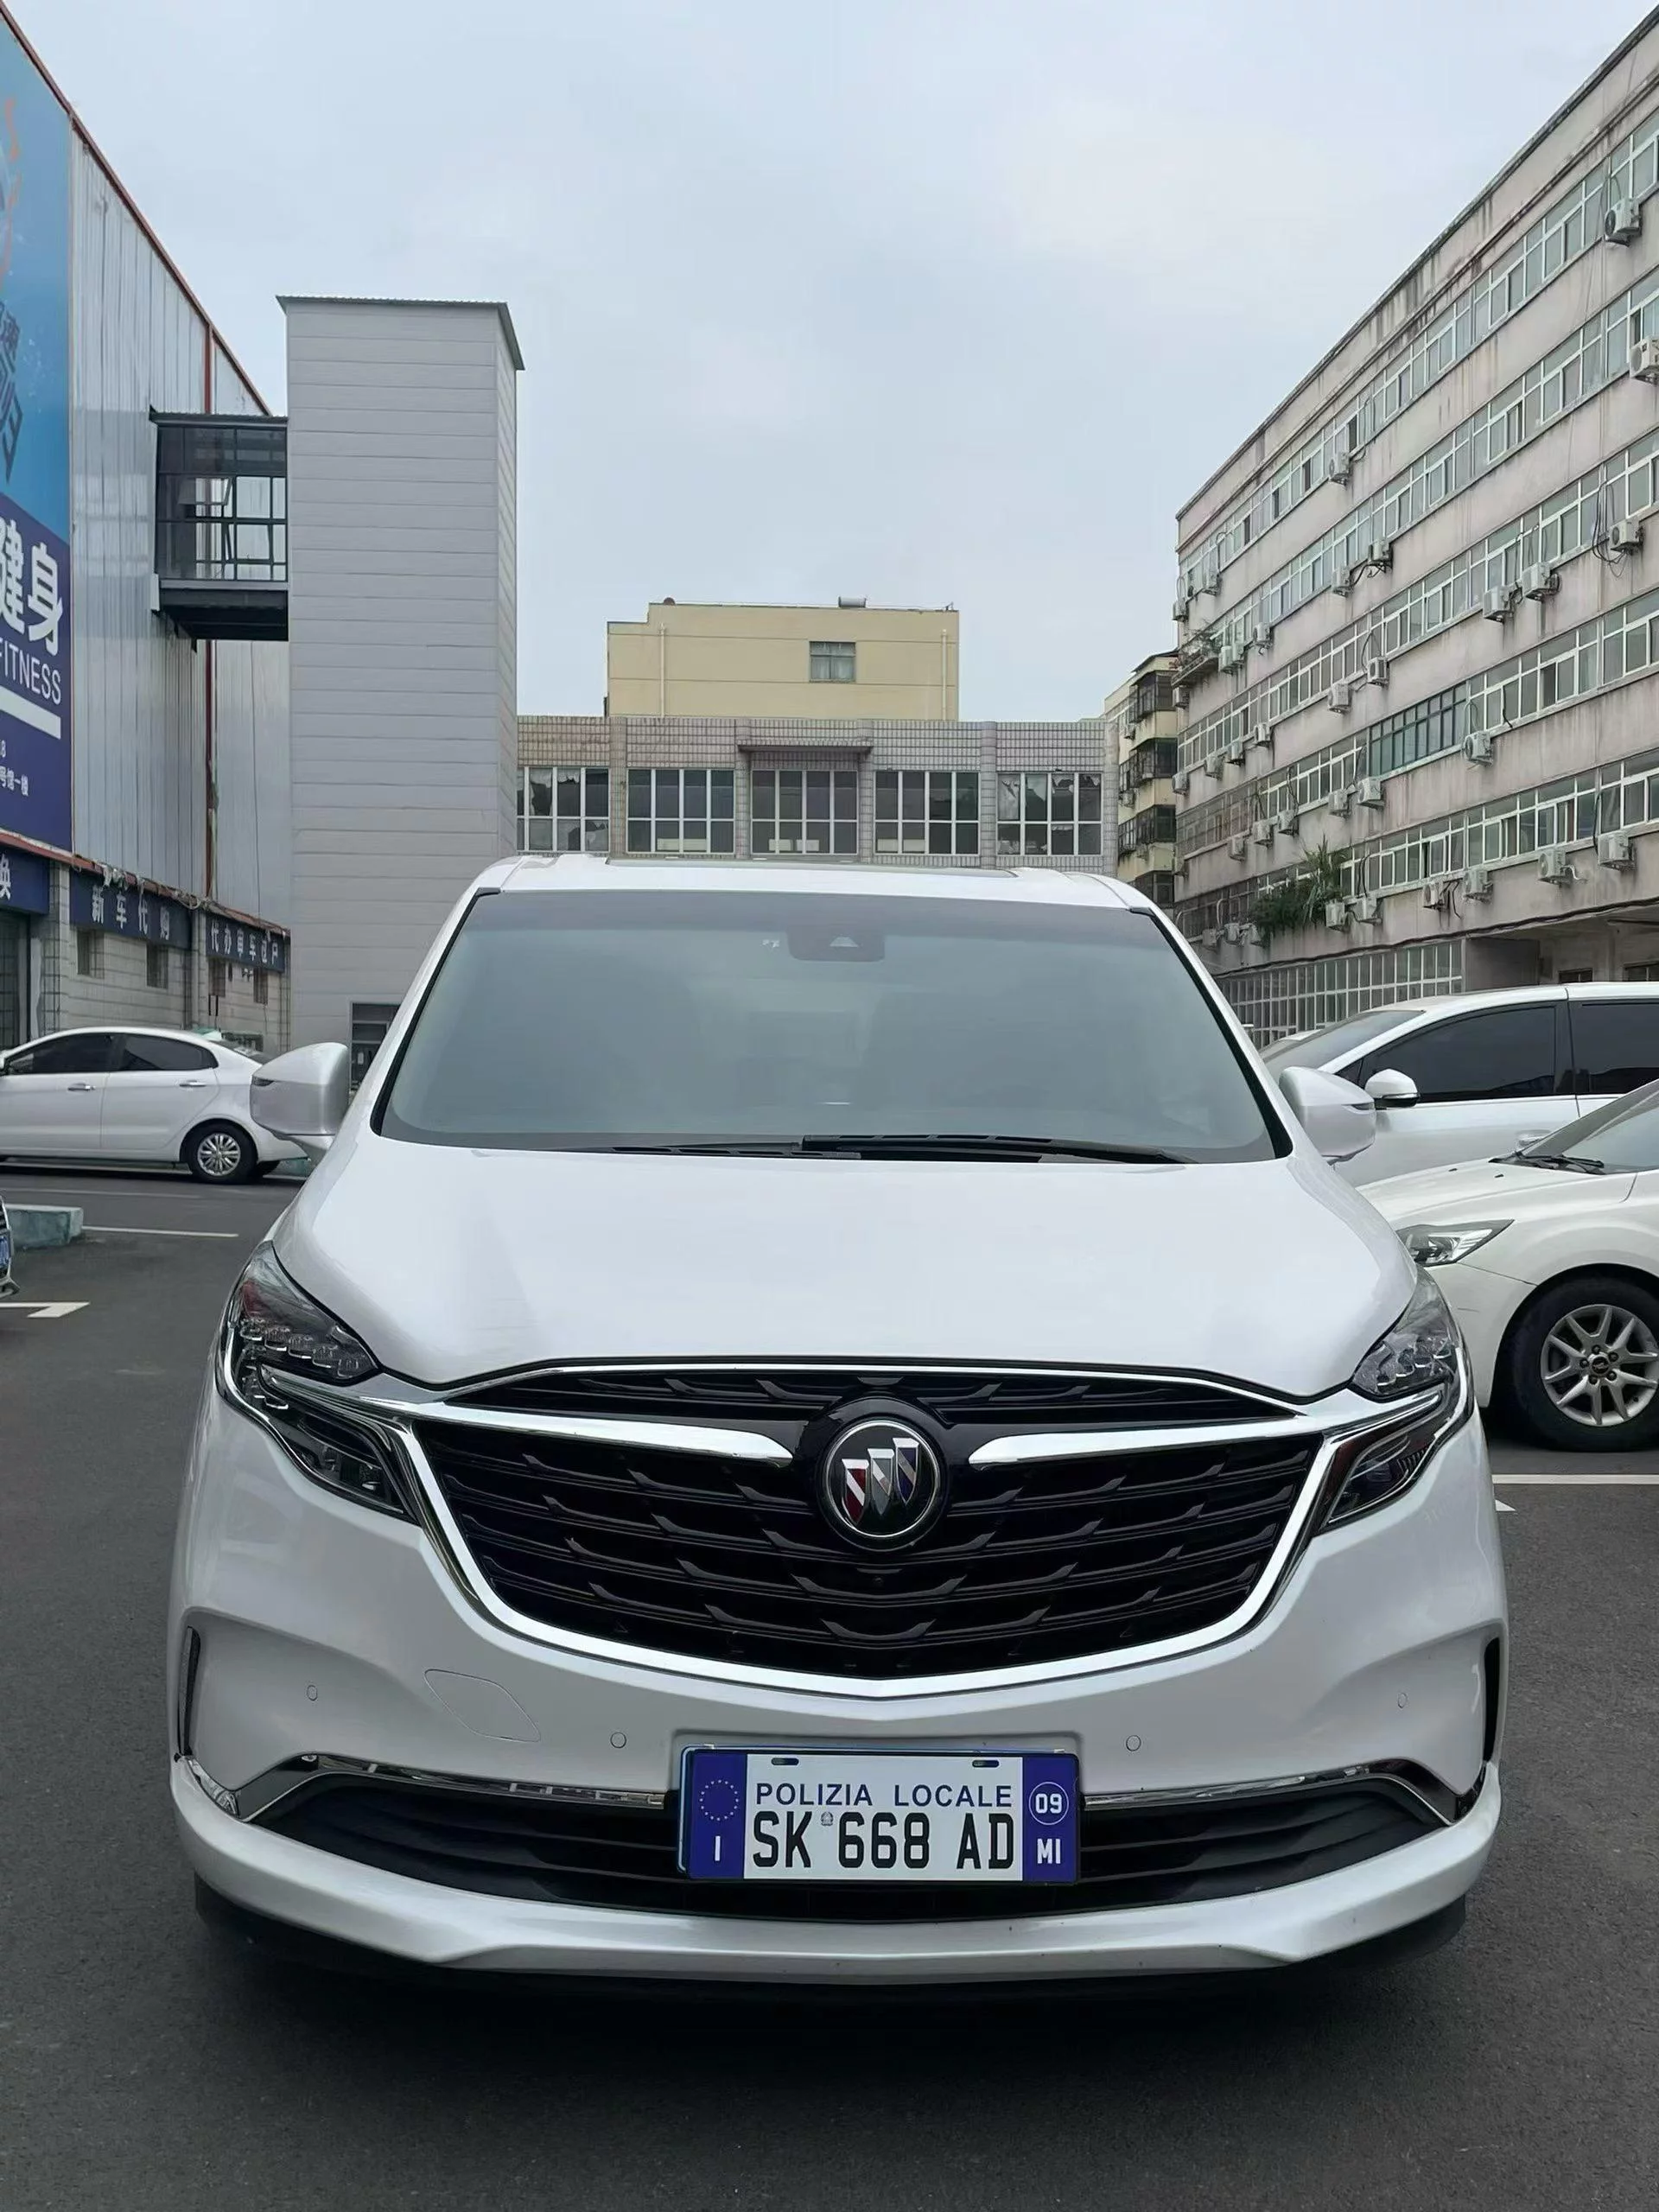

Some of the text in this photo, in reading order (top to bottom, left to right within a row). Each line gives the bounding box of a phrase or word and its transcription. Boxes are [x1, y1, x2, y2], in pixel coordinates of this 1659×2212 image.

[756, 1783, 1013, 1808] POLIZIA LOCALE
[1035, 1792, 1062, 1815] 09
[753, 1811, 1014, 1869] SK 668 AD
[1037, 1838, 1061, 1864] MI
